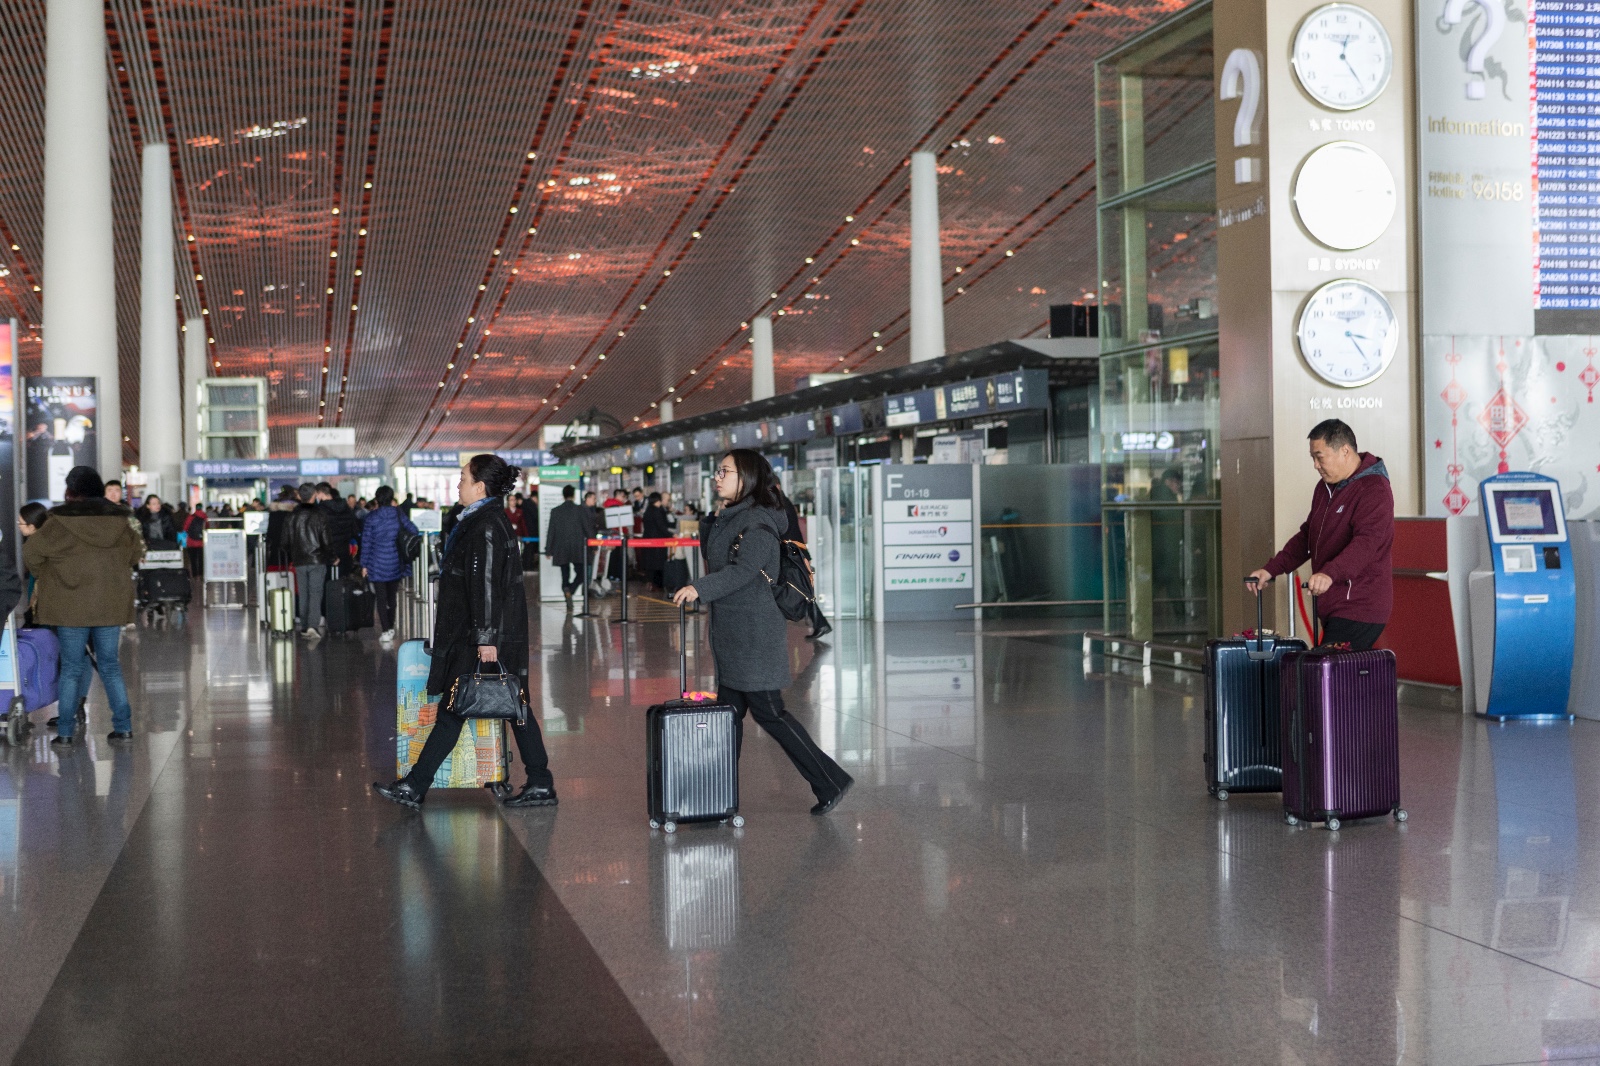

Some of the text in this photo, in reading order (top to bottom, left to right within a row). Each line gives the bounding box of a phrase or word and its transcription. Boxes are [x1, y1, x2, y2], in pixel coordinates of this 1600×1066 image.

[1336, 120, 1376, 131] TOKYO
[1428, 116, 1524, 137] Information
[1428, 181, 1523, 201] Hotline 96158
[1334, 259, 1380, 271] SYDNEY
[28, 386, 92, 397] SILENUS
[1015, 377, 1024, 404] F
[1337, 398, 1382, 408] LONDON
[887, 474, 930, 498] F 01-18
